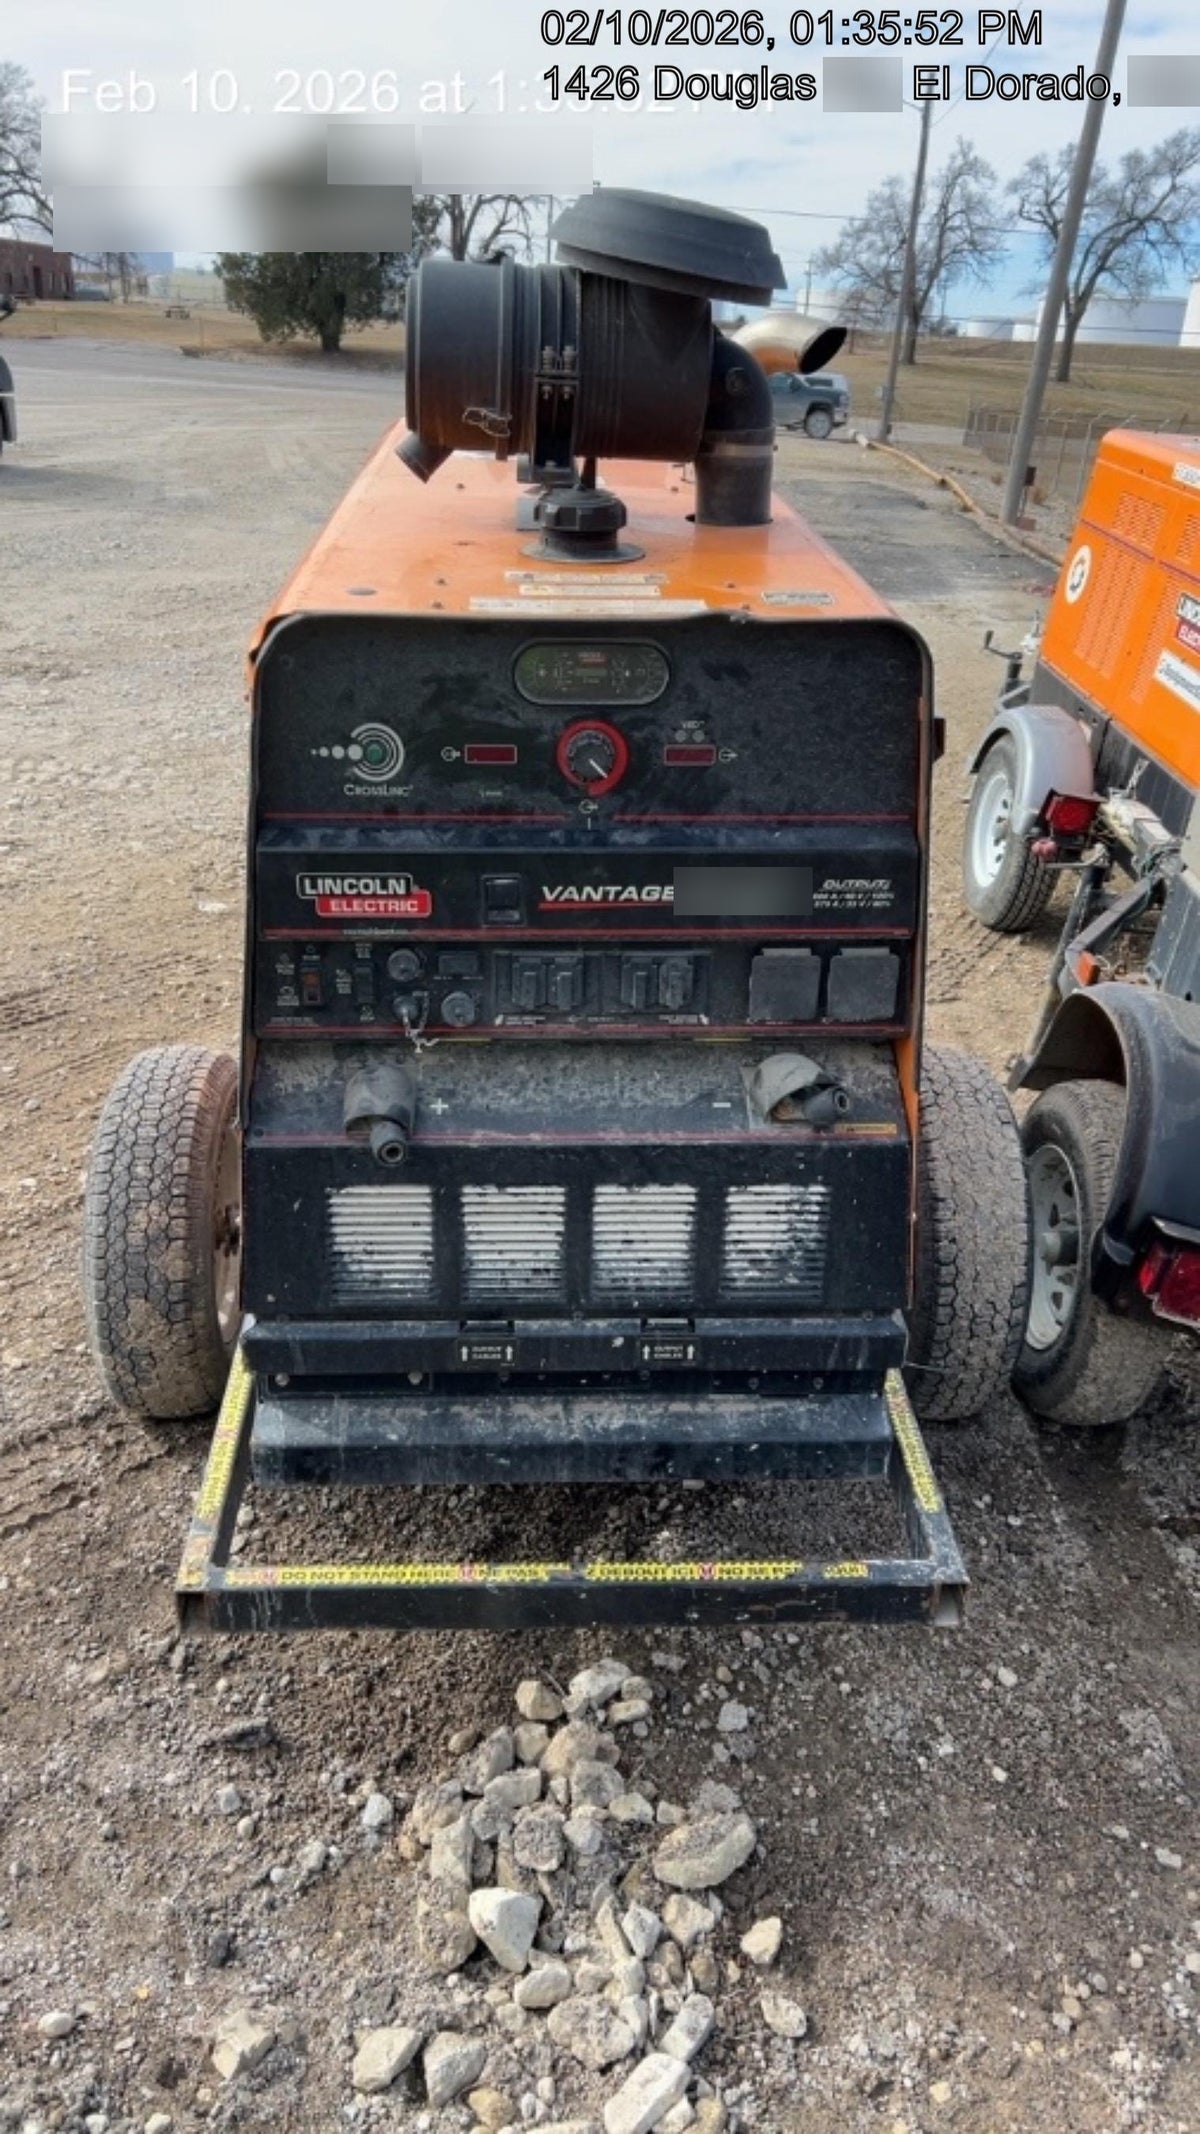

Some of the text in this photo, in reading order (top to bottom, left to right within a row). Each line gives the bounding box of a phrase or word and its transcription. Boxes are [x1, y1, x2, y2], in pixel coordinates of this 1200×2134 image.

[304, 878, 406, 895] LINCOLN
[541, 885, 675, 902] VANTAGE
[330, 898, 419, 912] ELECTRIC
[281, 1571, 307, 1580] DO
[310, 1571, 344, 1580] NOT
[349, 1570, 407, 1580] STAND
[409, 1570, 452, 1579] HERE
[719, 1566, 743, 1577] NO
